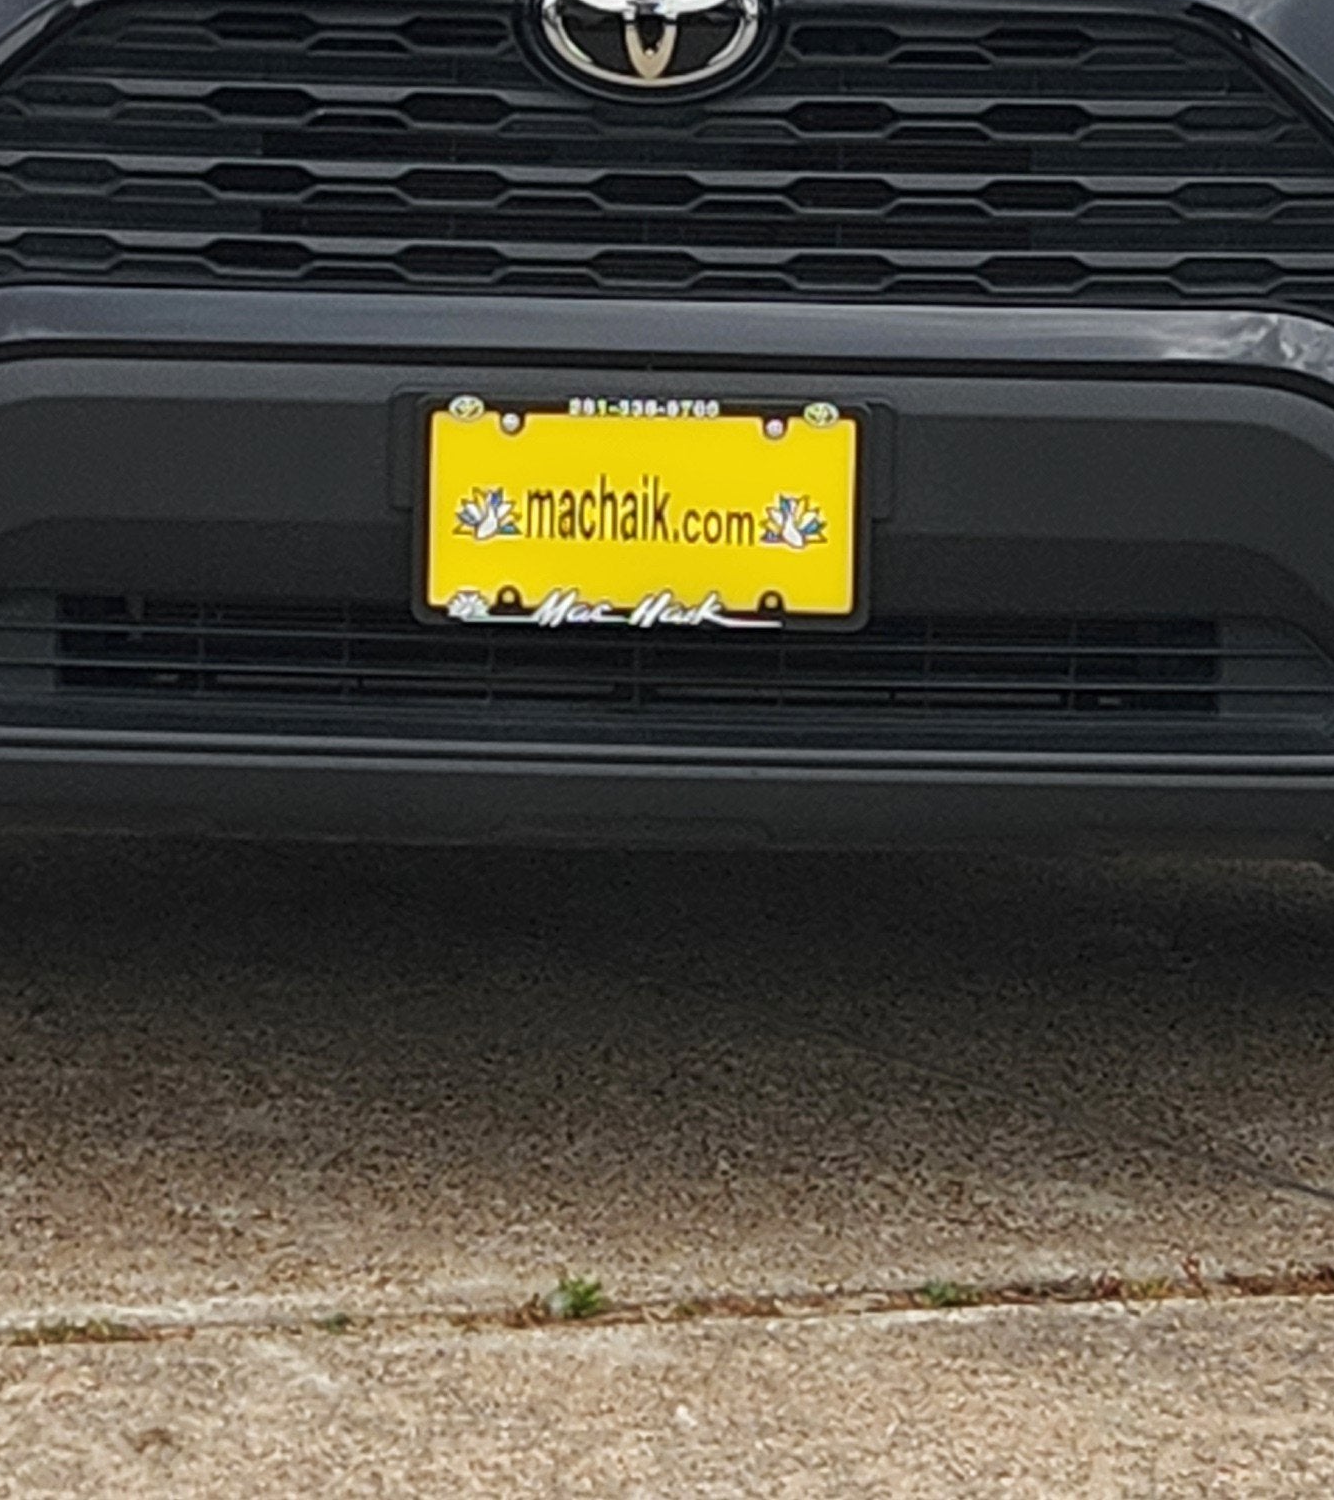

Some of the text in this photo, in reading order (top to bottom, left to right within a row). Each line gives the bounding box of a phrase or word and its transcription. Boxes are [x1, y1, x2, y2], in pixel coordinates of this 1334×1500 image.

[524, 473, 755, 546] machaik.com
[532, 587, 723, 628] Mac Haik
